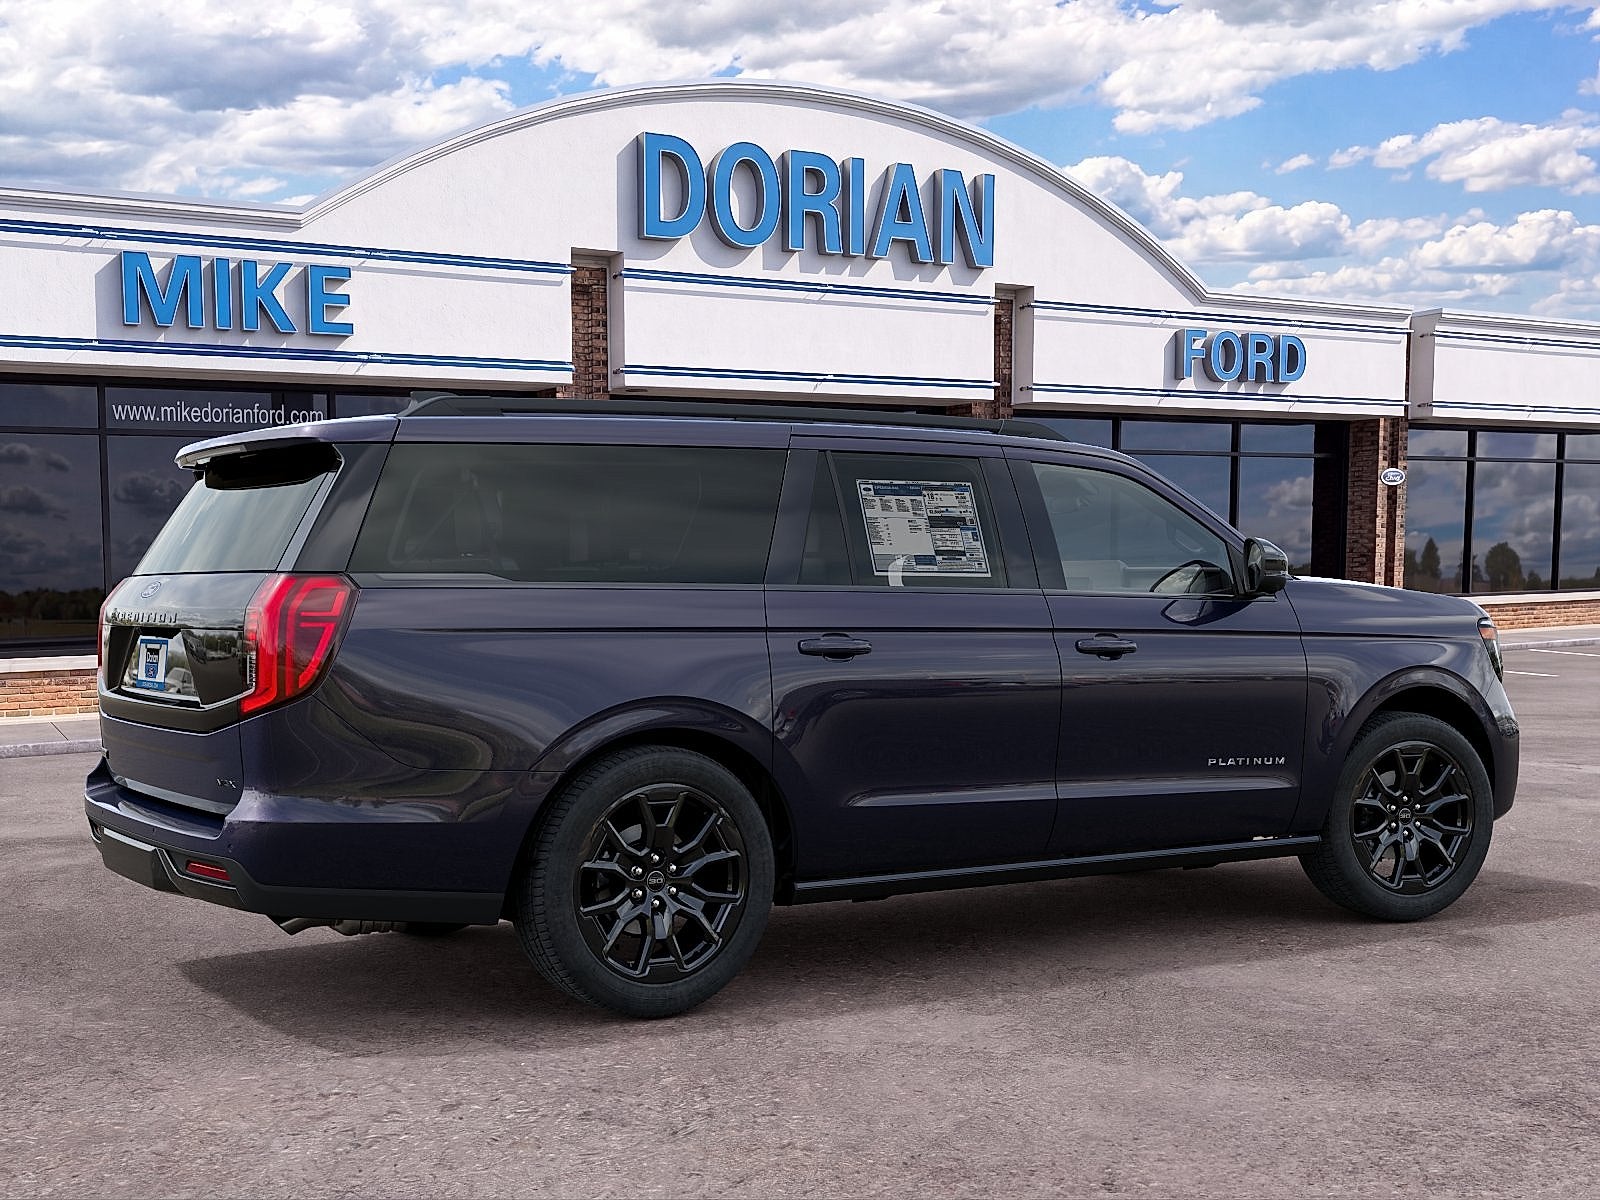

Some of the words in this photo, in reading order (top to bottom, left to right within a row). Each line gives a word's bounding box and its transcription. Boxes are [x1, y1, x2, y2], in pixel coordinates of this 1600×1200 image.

[638, 131, 996, 268] DORIAN
[121, 250, 354, 335] MIKE
[1176, 328, 1307, 383] FORD
[112, 401, 324, 424] www.mikedorianford.com
[111, 611, 178, 624] EXPEDITION
[1207, 757, 1286, 767] PLATINUM
